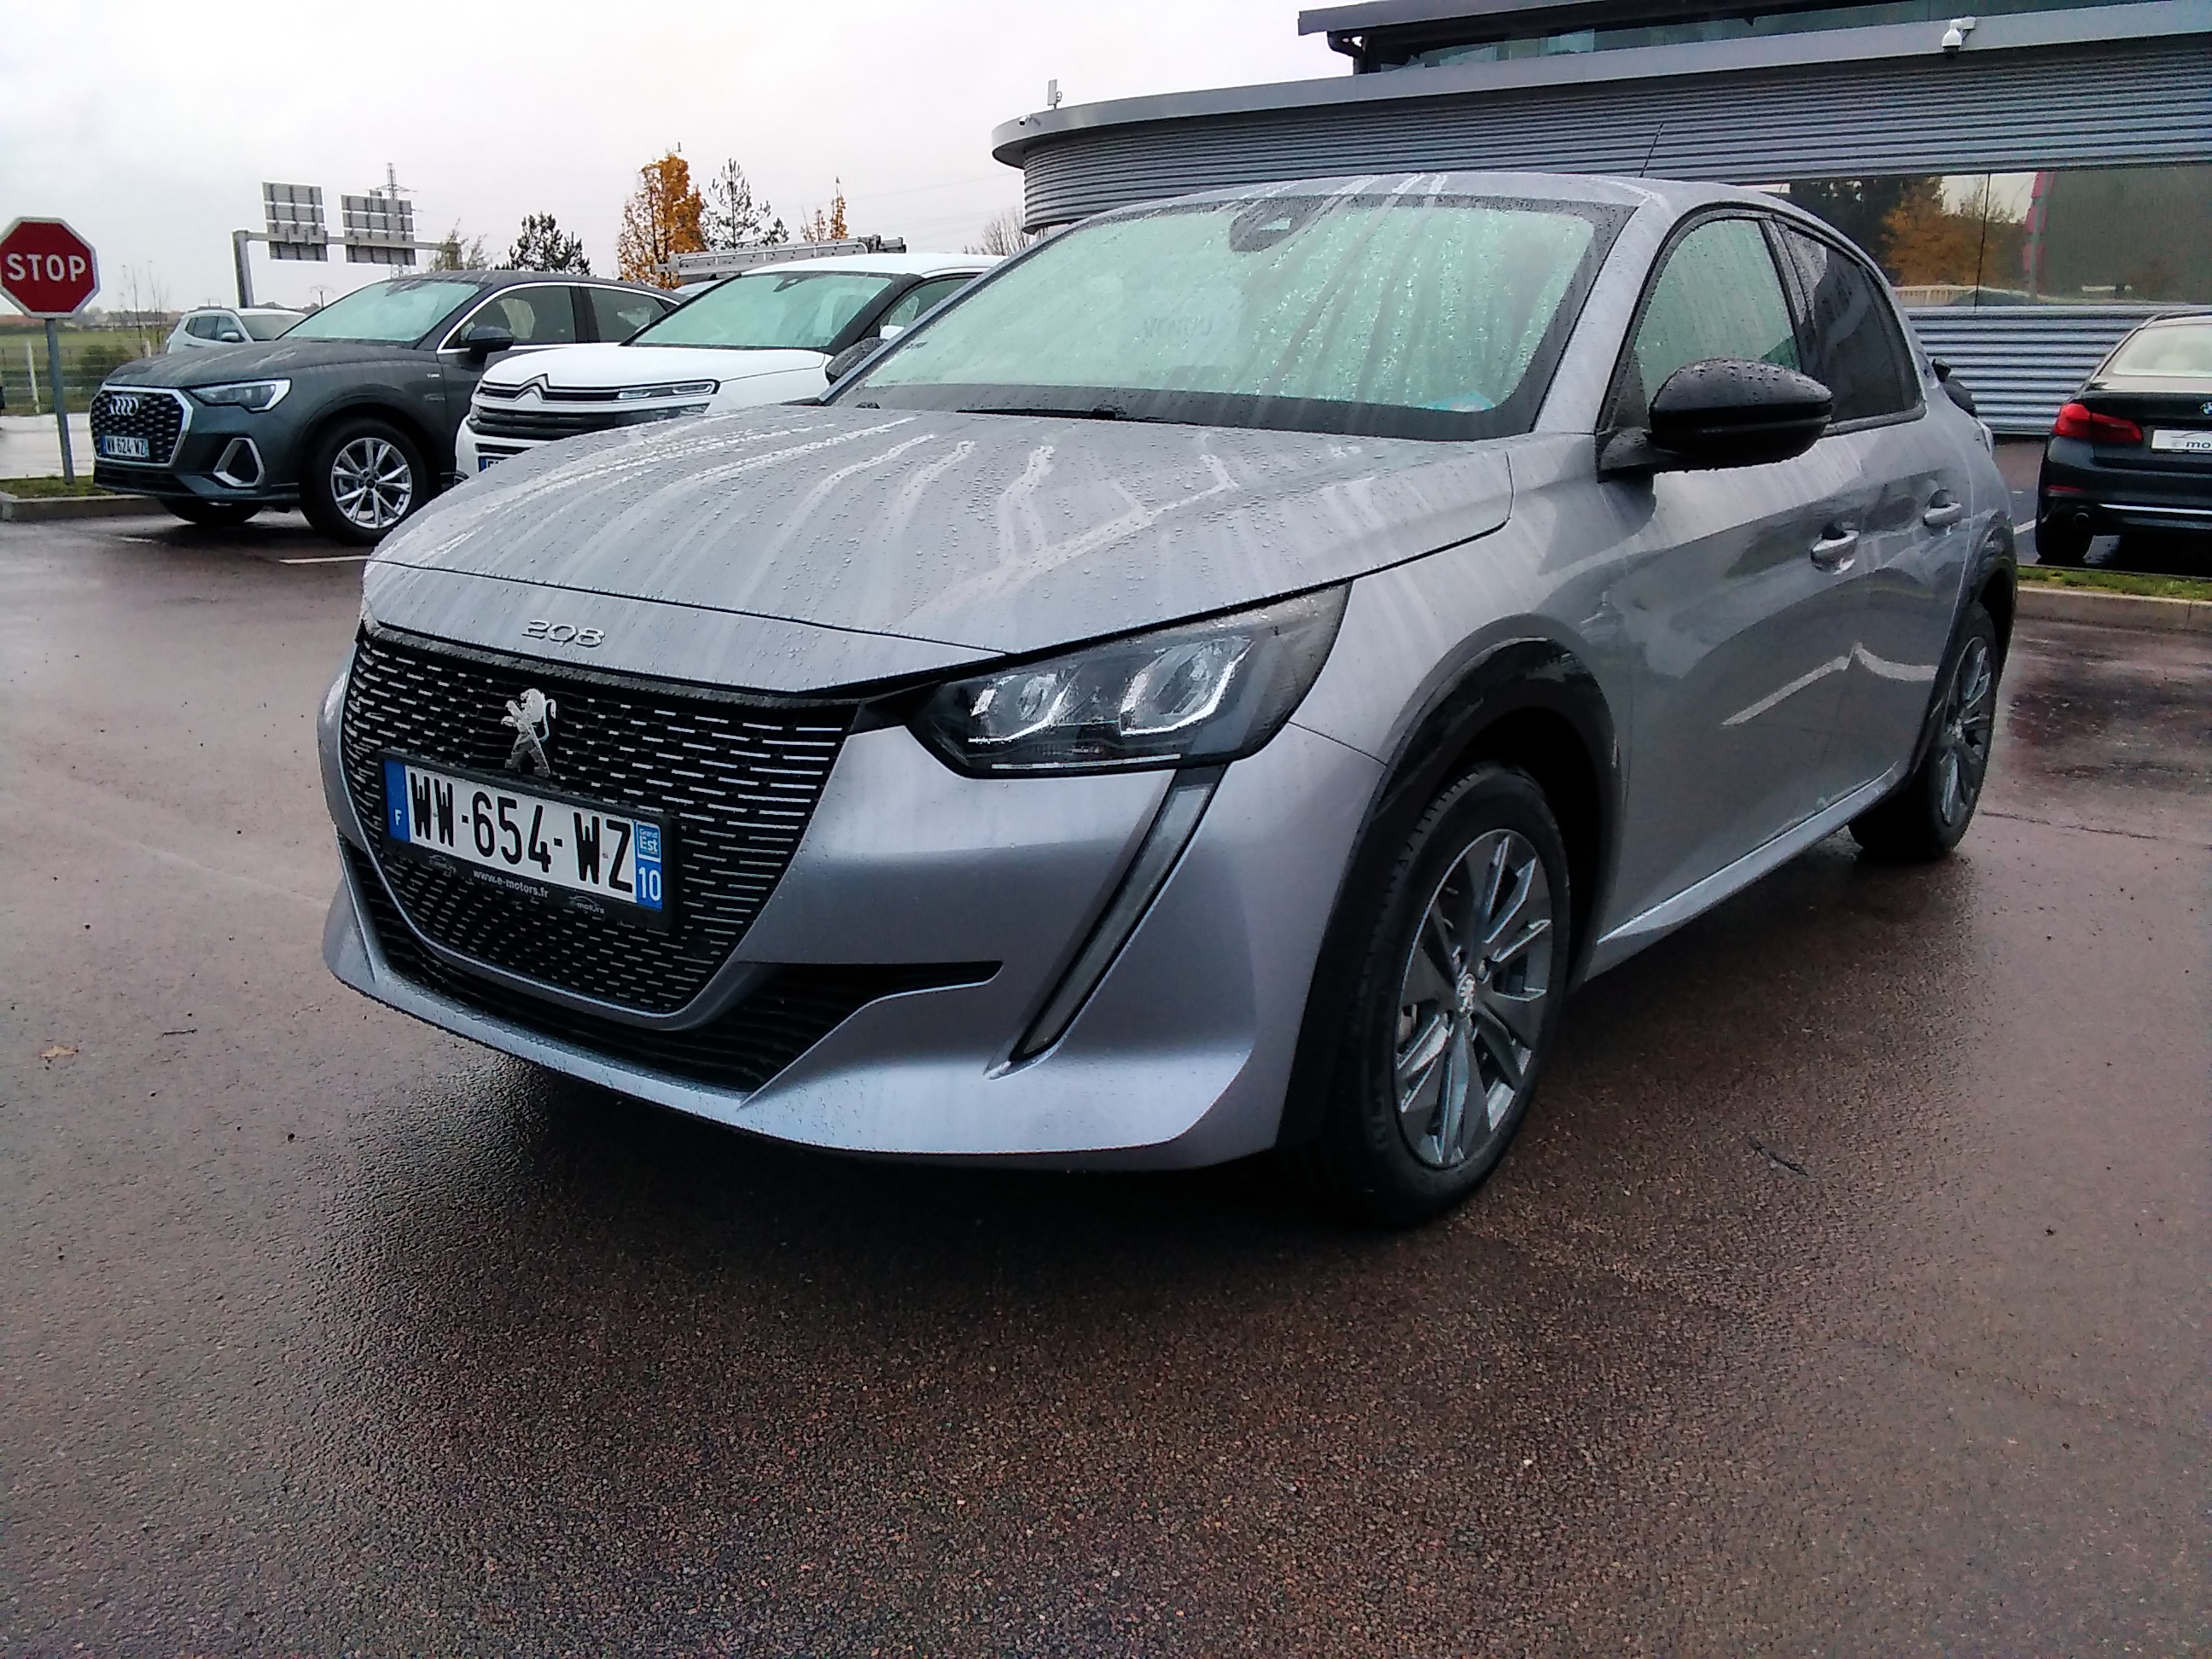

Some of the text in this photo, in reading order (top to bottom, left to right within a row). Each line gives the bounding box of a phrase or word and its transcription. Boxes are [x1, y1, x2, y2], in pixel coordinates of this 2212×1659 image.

[7, 253, 86, 282] STOP
[521, 620, 606, 649] 208
[395, 808, 402, 827] F
[639, 835, 658, 853] Est
[473, 870, 550, 899] www.e-motors.fr
[638, 866, 661, 901] 10
